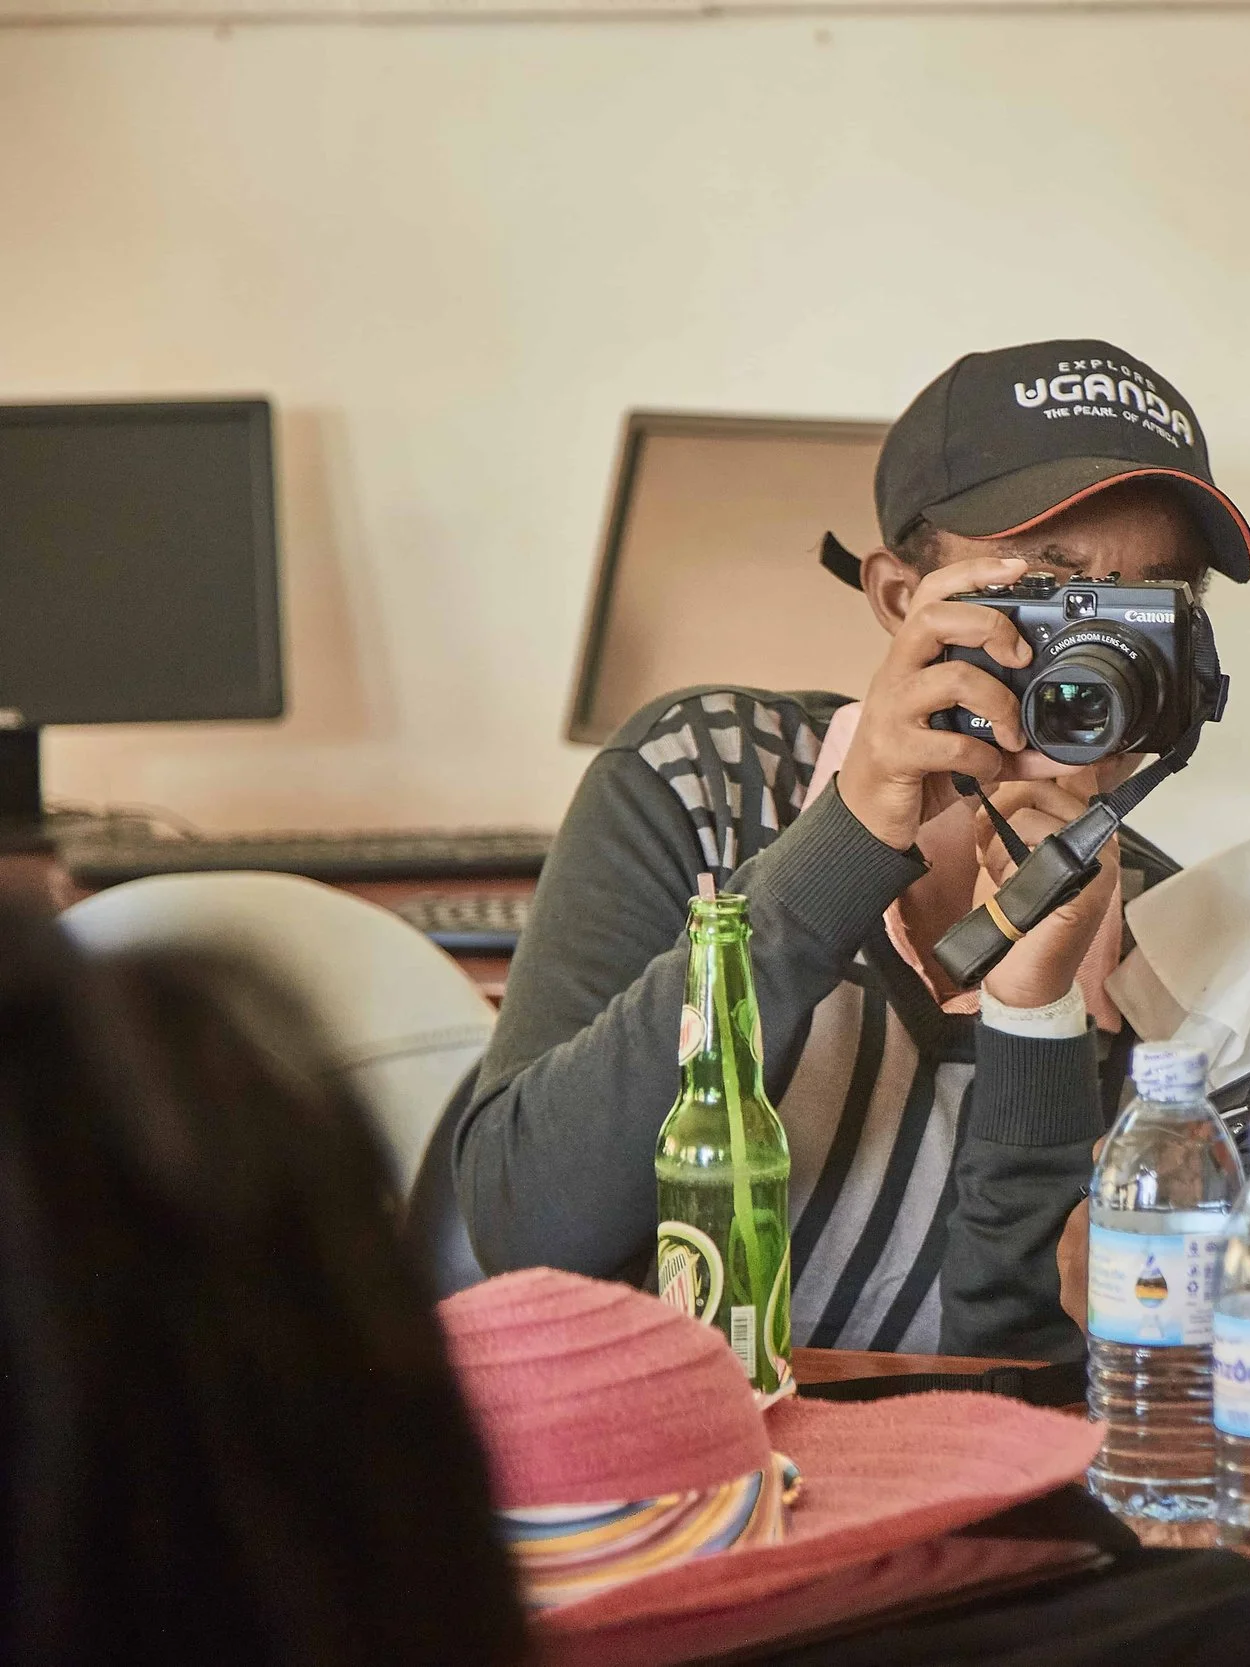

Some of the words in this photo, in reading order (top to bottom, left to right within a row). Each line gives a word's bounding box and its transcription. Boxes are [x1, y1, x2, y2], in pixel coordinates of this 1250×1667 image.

[1058, 359, 1156, 391] EXPLORE
[1014, 373, 1194, 447] UGANDA
[1043, 406, 1070, 419] THE
[1073, 404, 1118, 418] PEARL
[1122, 410, 1139, 423] OF
[1124, 610, 1175, 623] Canon
[1049, 636, 1076, 656] CANON
[1075, 633, 1101, 642] ZOOM
[1101, 635, 1121, 647] LENS
[1128, 651, 1138, 660] IS
